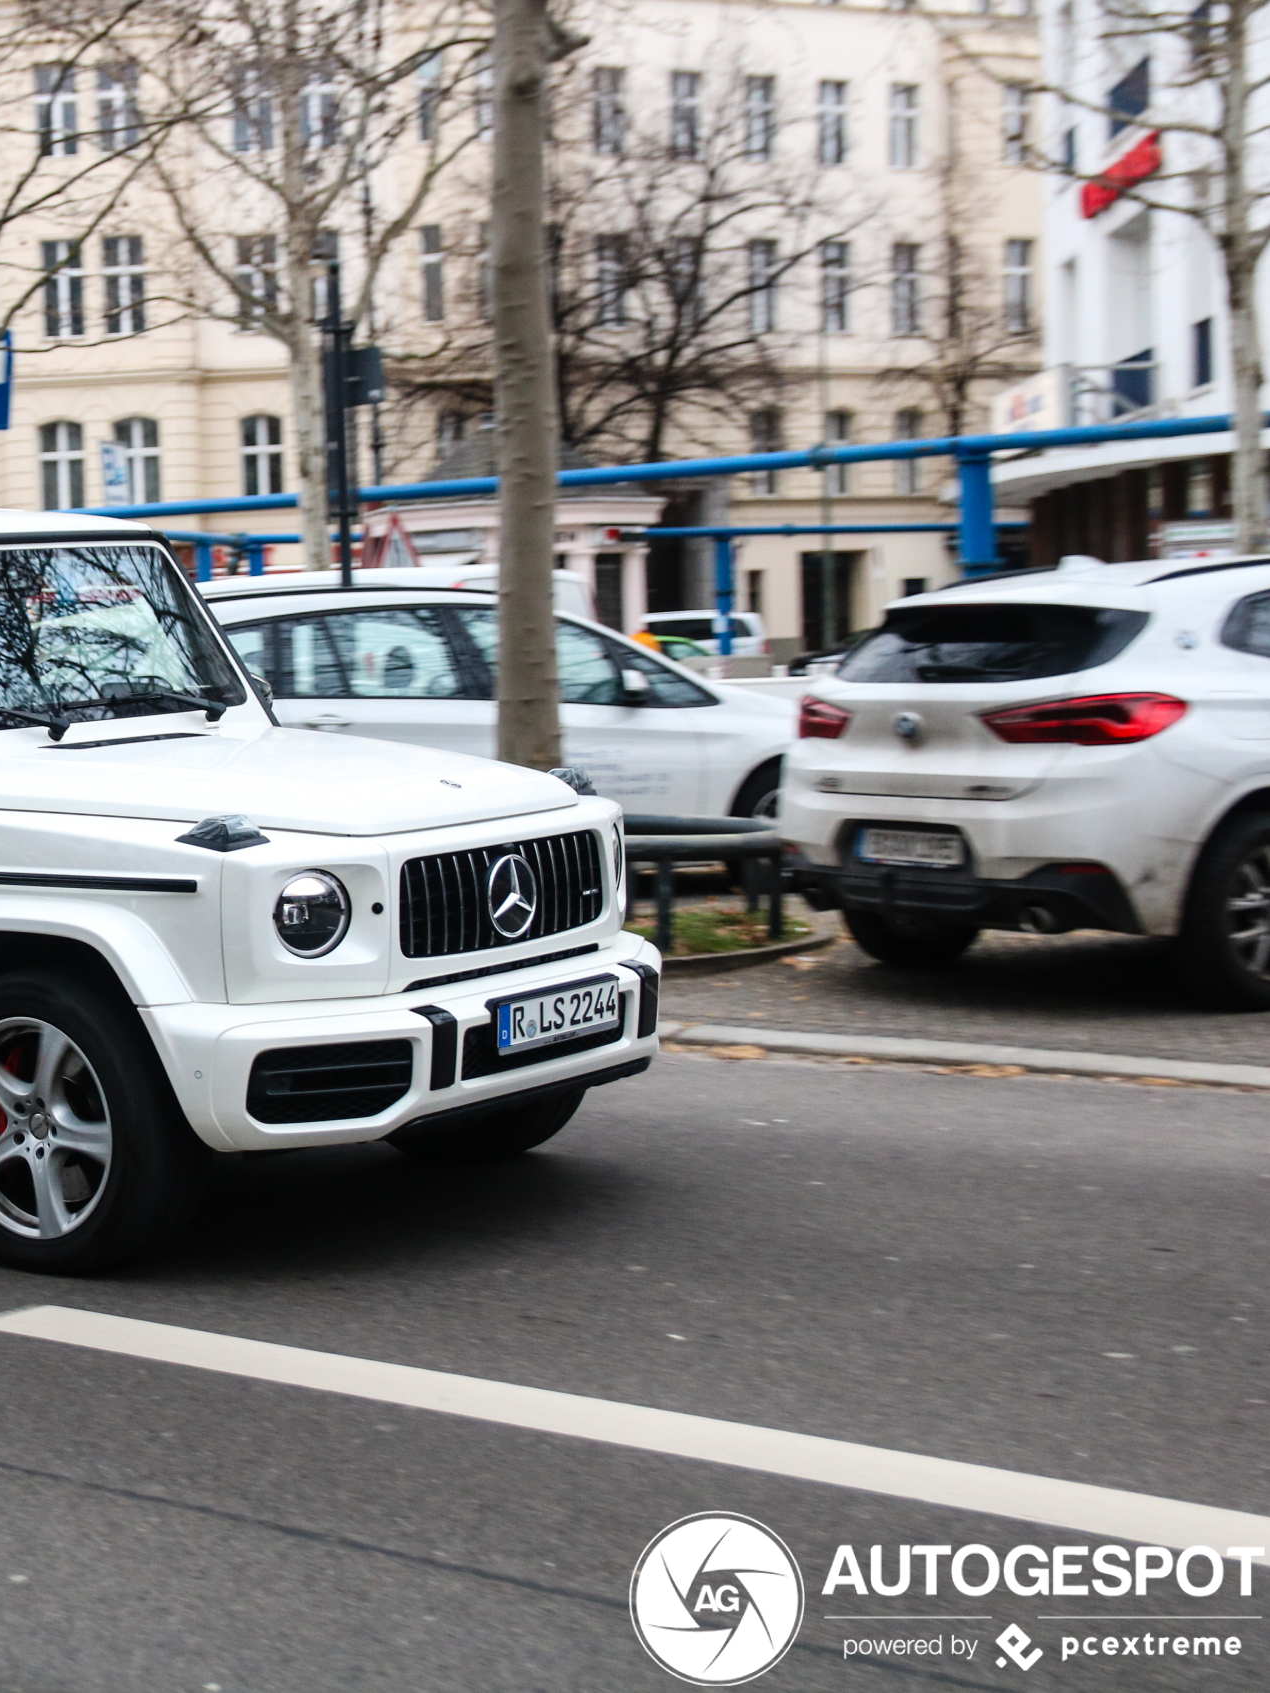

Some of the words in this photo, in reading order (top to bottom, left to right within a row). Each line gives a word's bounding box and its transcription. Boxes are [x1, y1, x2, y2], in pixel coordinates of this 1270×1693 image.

[513, 1006, 525, 1039] R
[540, 997, 565, 1033] LS
[570, 985, 616, 1026] 2244
[502, 1030, 508, 1040] D
